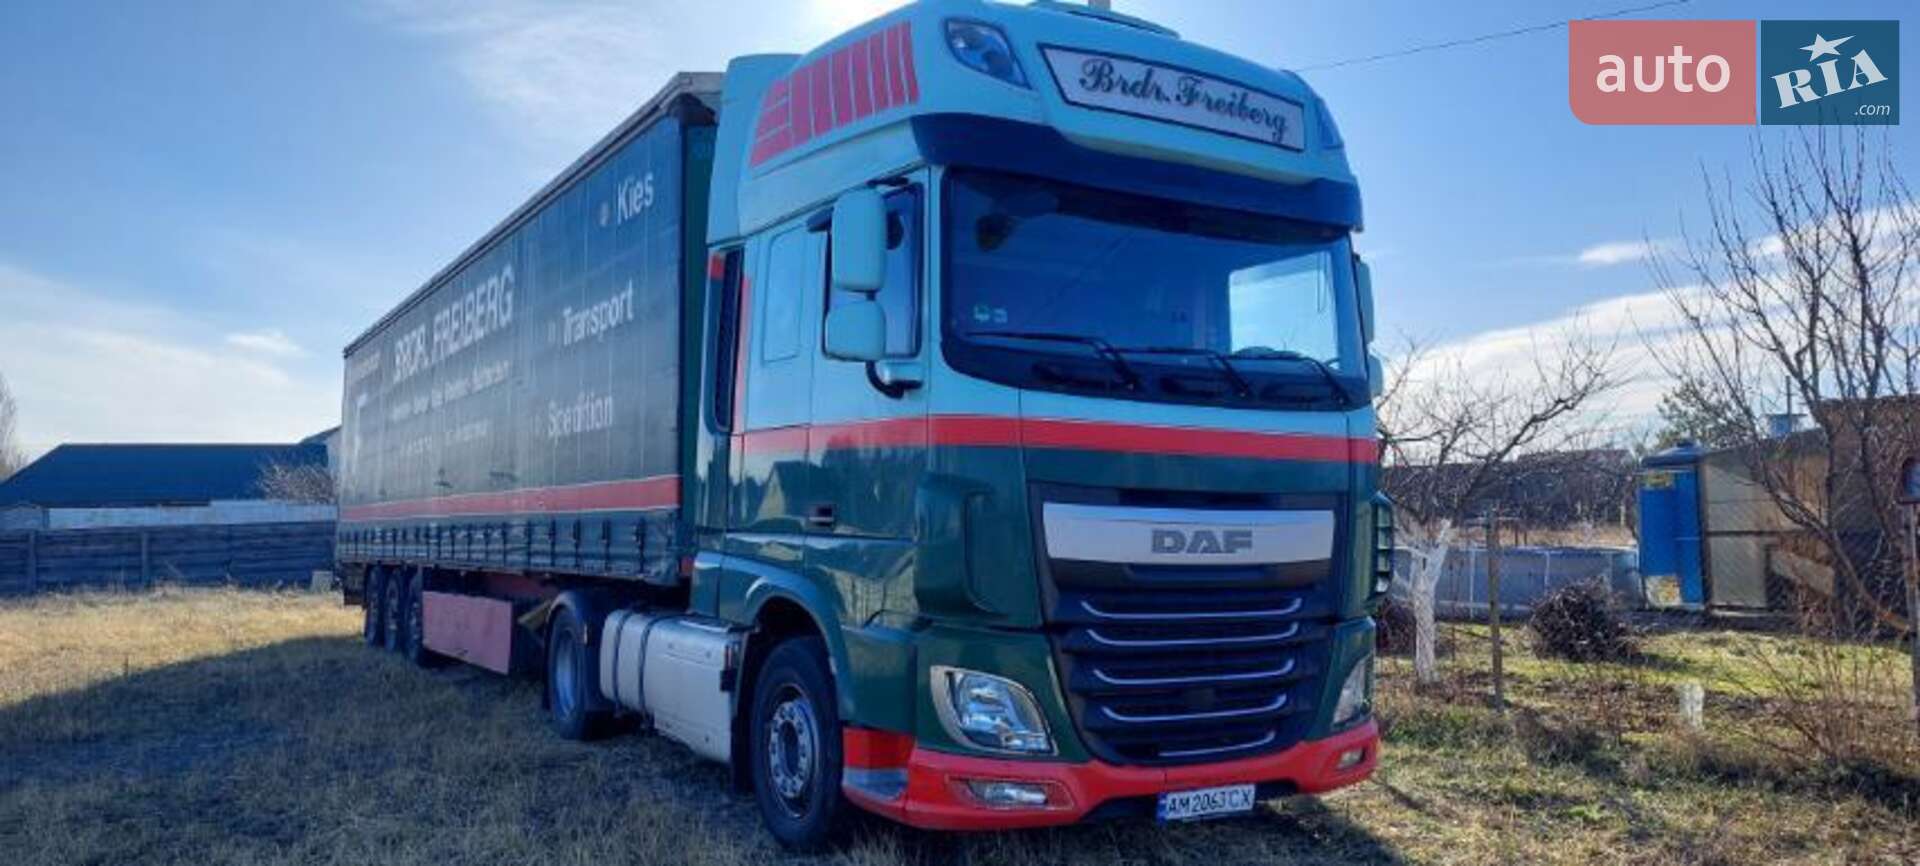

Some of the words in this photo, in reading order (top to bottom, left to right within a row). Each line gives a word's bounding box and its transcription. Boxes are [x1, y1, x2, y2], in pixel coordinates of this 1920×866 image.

[1078, 57, 1171, 102] Brdr.
[1174, 75, 1289, 143] Freiberg
[616, 172, 654, 225] Kies
[431, 263, 515, 365] FREIBERG
[562, 280, 634, 346] Transport
[548, 391, 613, 446] Spedition
[1151, 529, 1253, 554] DAF
